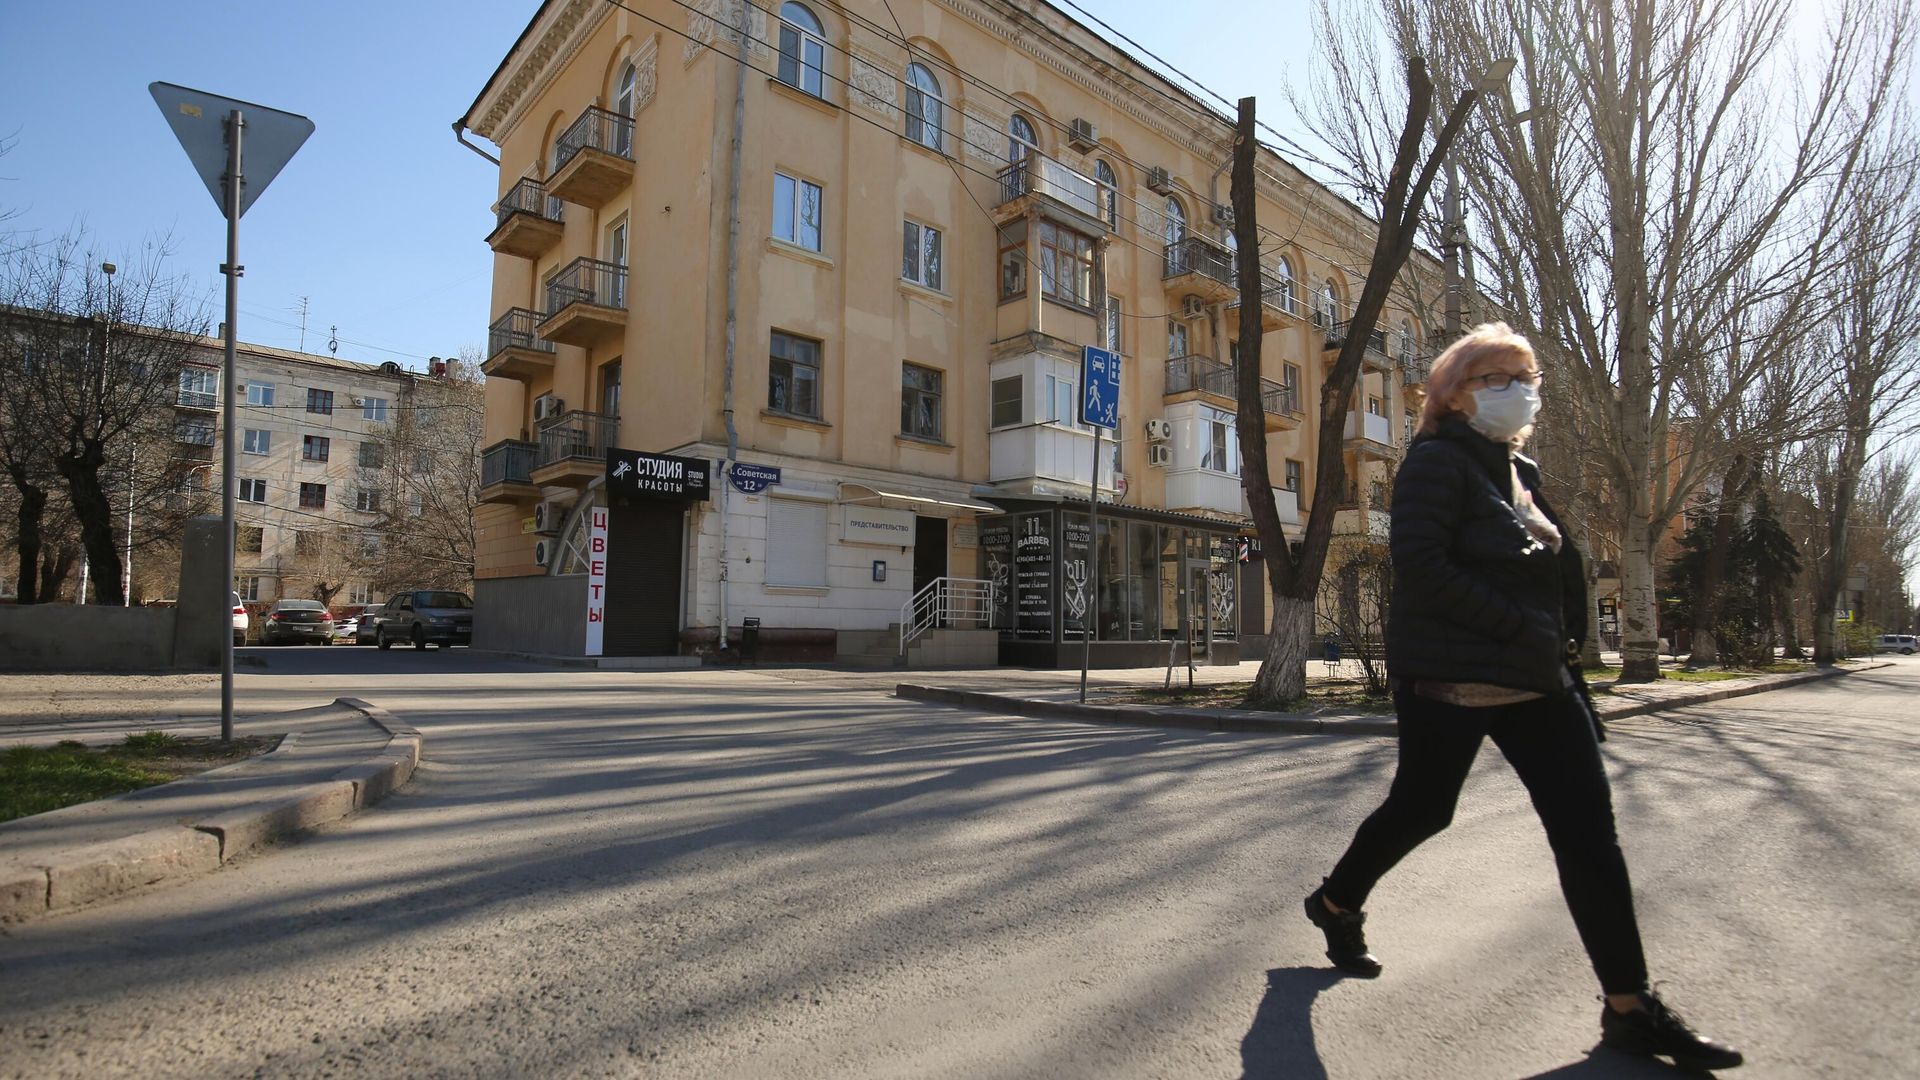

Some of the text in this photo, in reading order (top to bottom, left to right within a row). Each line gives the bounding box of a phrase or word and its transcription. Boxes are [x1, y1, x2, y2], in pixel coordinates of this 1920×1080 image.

[637, 457, 683, 479] СТУДИЯ
[736, 467, 777, 480] Советская
[638, 479, 683, 493] КРАСОТЫ
[743, 480, 756, 491] 12
[850, 520, 909, 532] ПРЕДСТАВИТЕЛЬСТВО
[1026, 517, 1040, 536] 11
[1017, 535, 1050, 549] BARBER
[589, 513, 606, 622] ЦВЕТЫ
